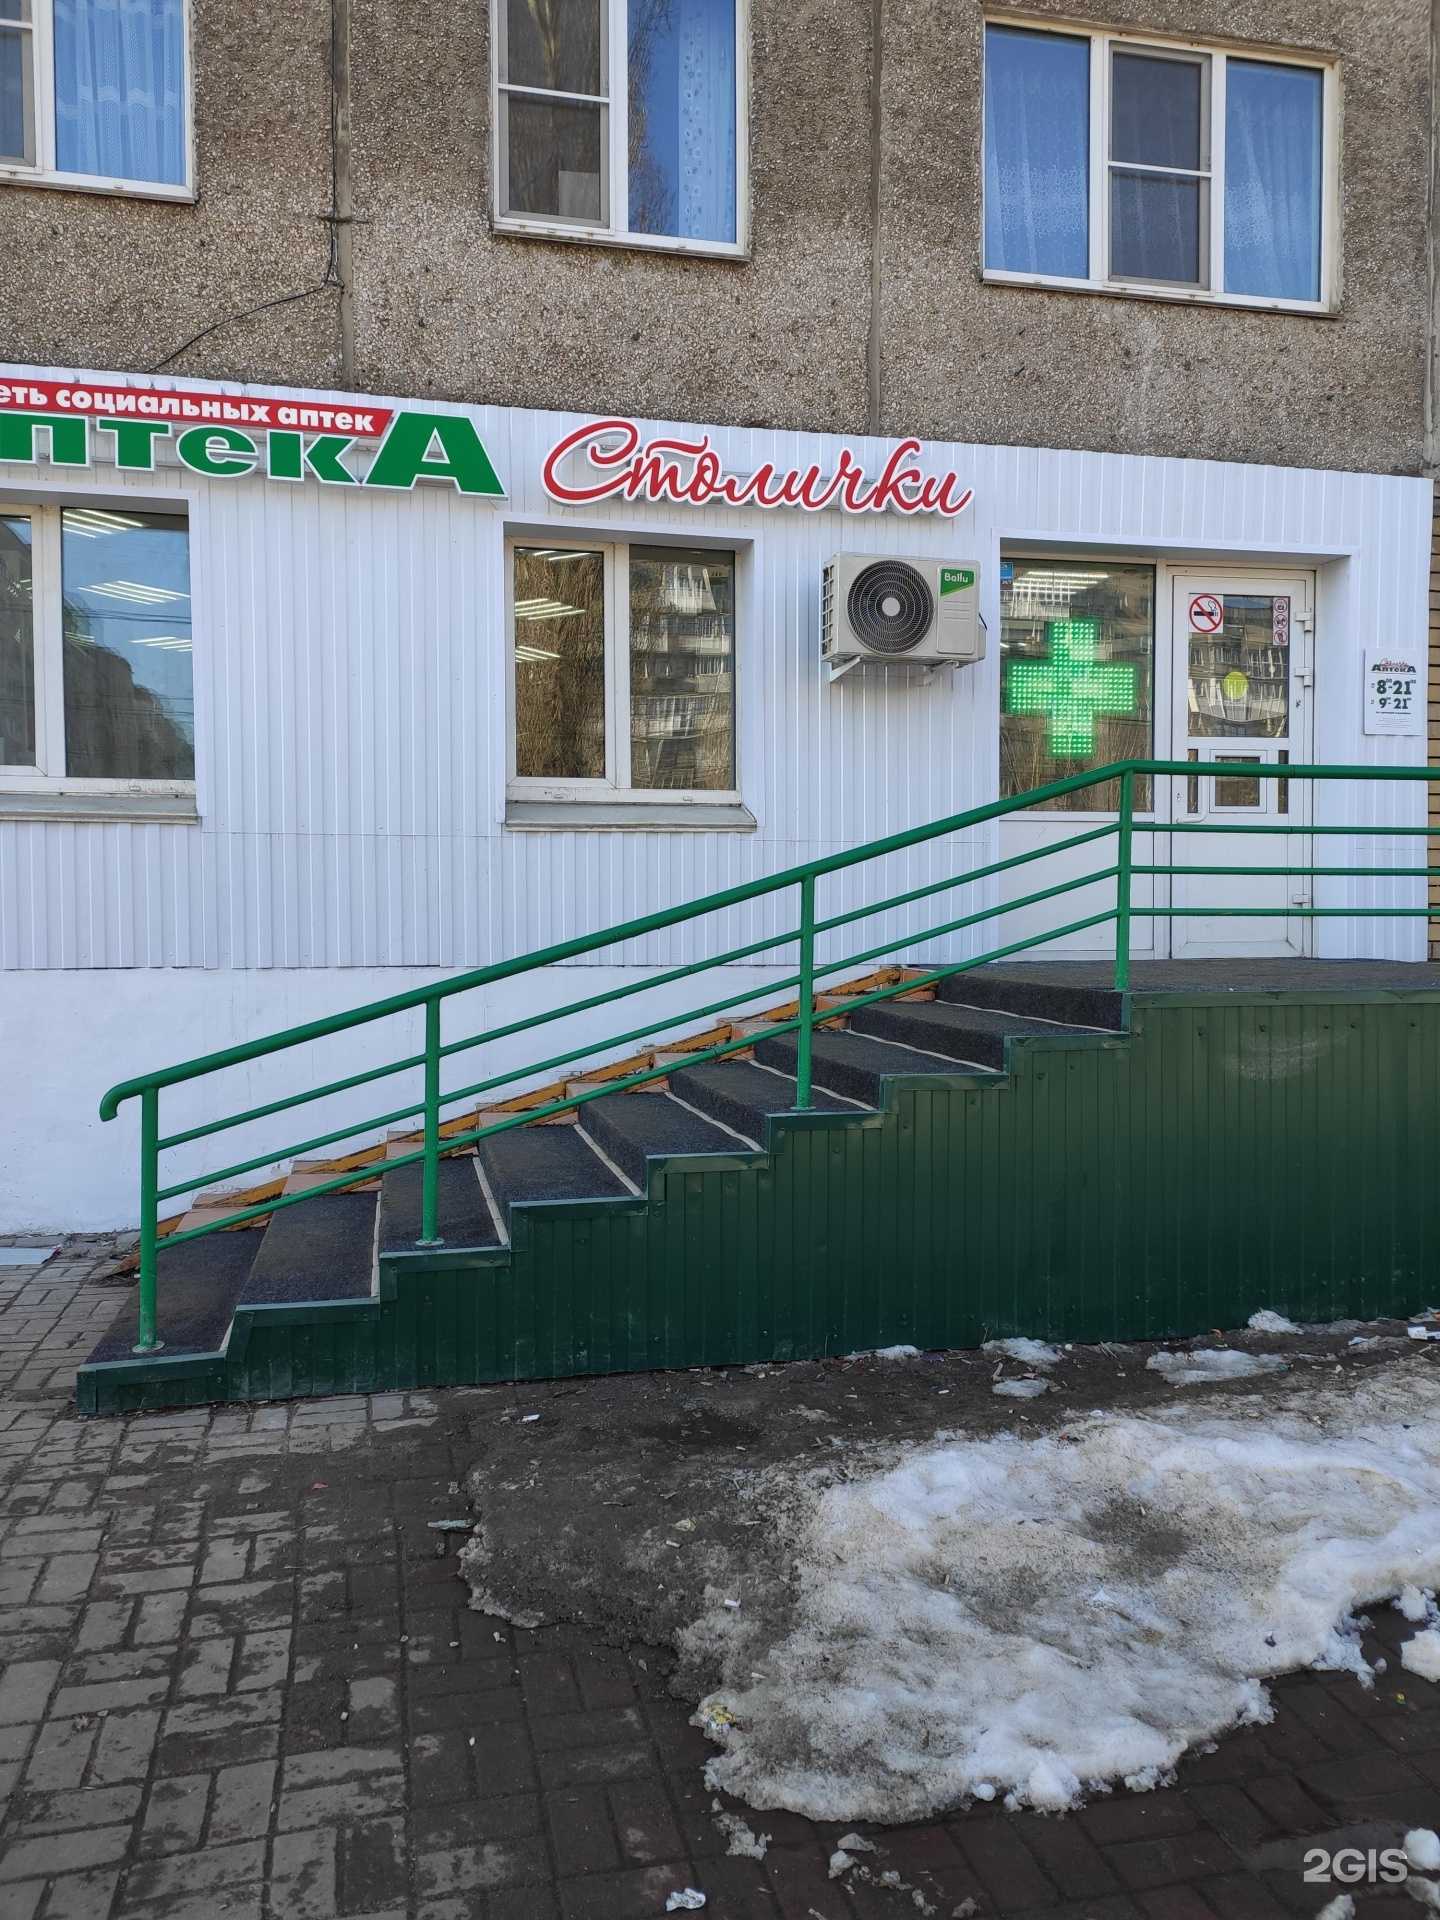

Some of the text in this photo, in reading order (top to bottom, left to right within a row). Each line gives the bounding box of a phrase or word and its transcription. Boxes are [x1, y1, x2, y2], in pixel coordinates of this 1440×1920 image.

[55, 389, 270, 424] социальных
[277, 407, 375, 433] аптек
[541, 419, 973, 517] Столички
